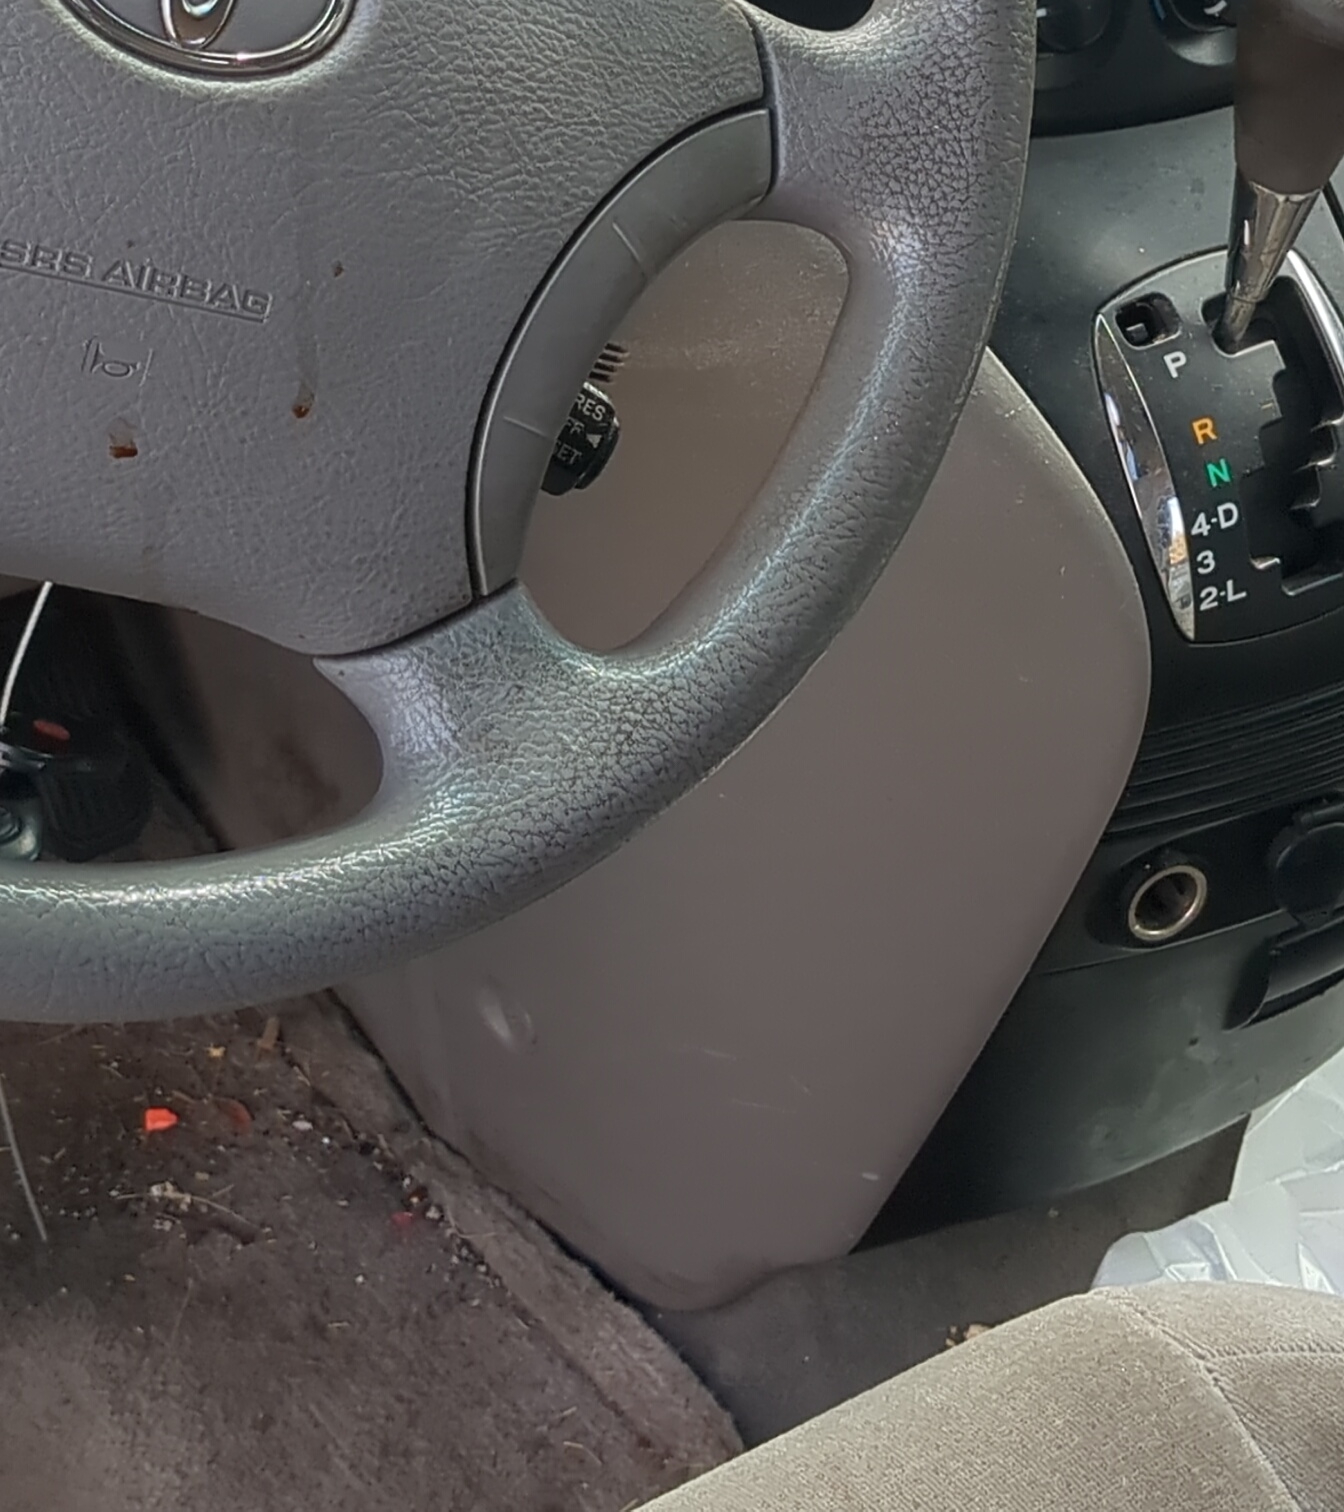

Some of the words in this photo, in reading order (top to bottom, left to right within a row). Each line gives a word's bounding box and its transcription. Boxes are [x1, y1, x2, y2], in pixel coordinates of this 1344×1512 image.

[0, 238, 94, 279] SRS
[101, 258, 274, 317] AIRBAG
[1163, 350, 1188, 379] P
[1191, 416, 1218, 445] R
[556, 439, 583, 465] ET
[1206, 458, 1232, 488] N
[1196, 549, 1216, 575] 3
